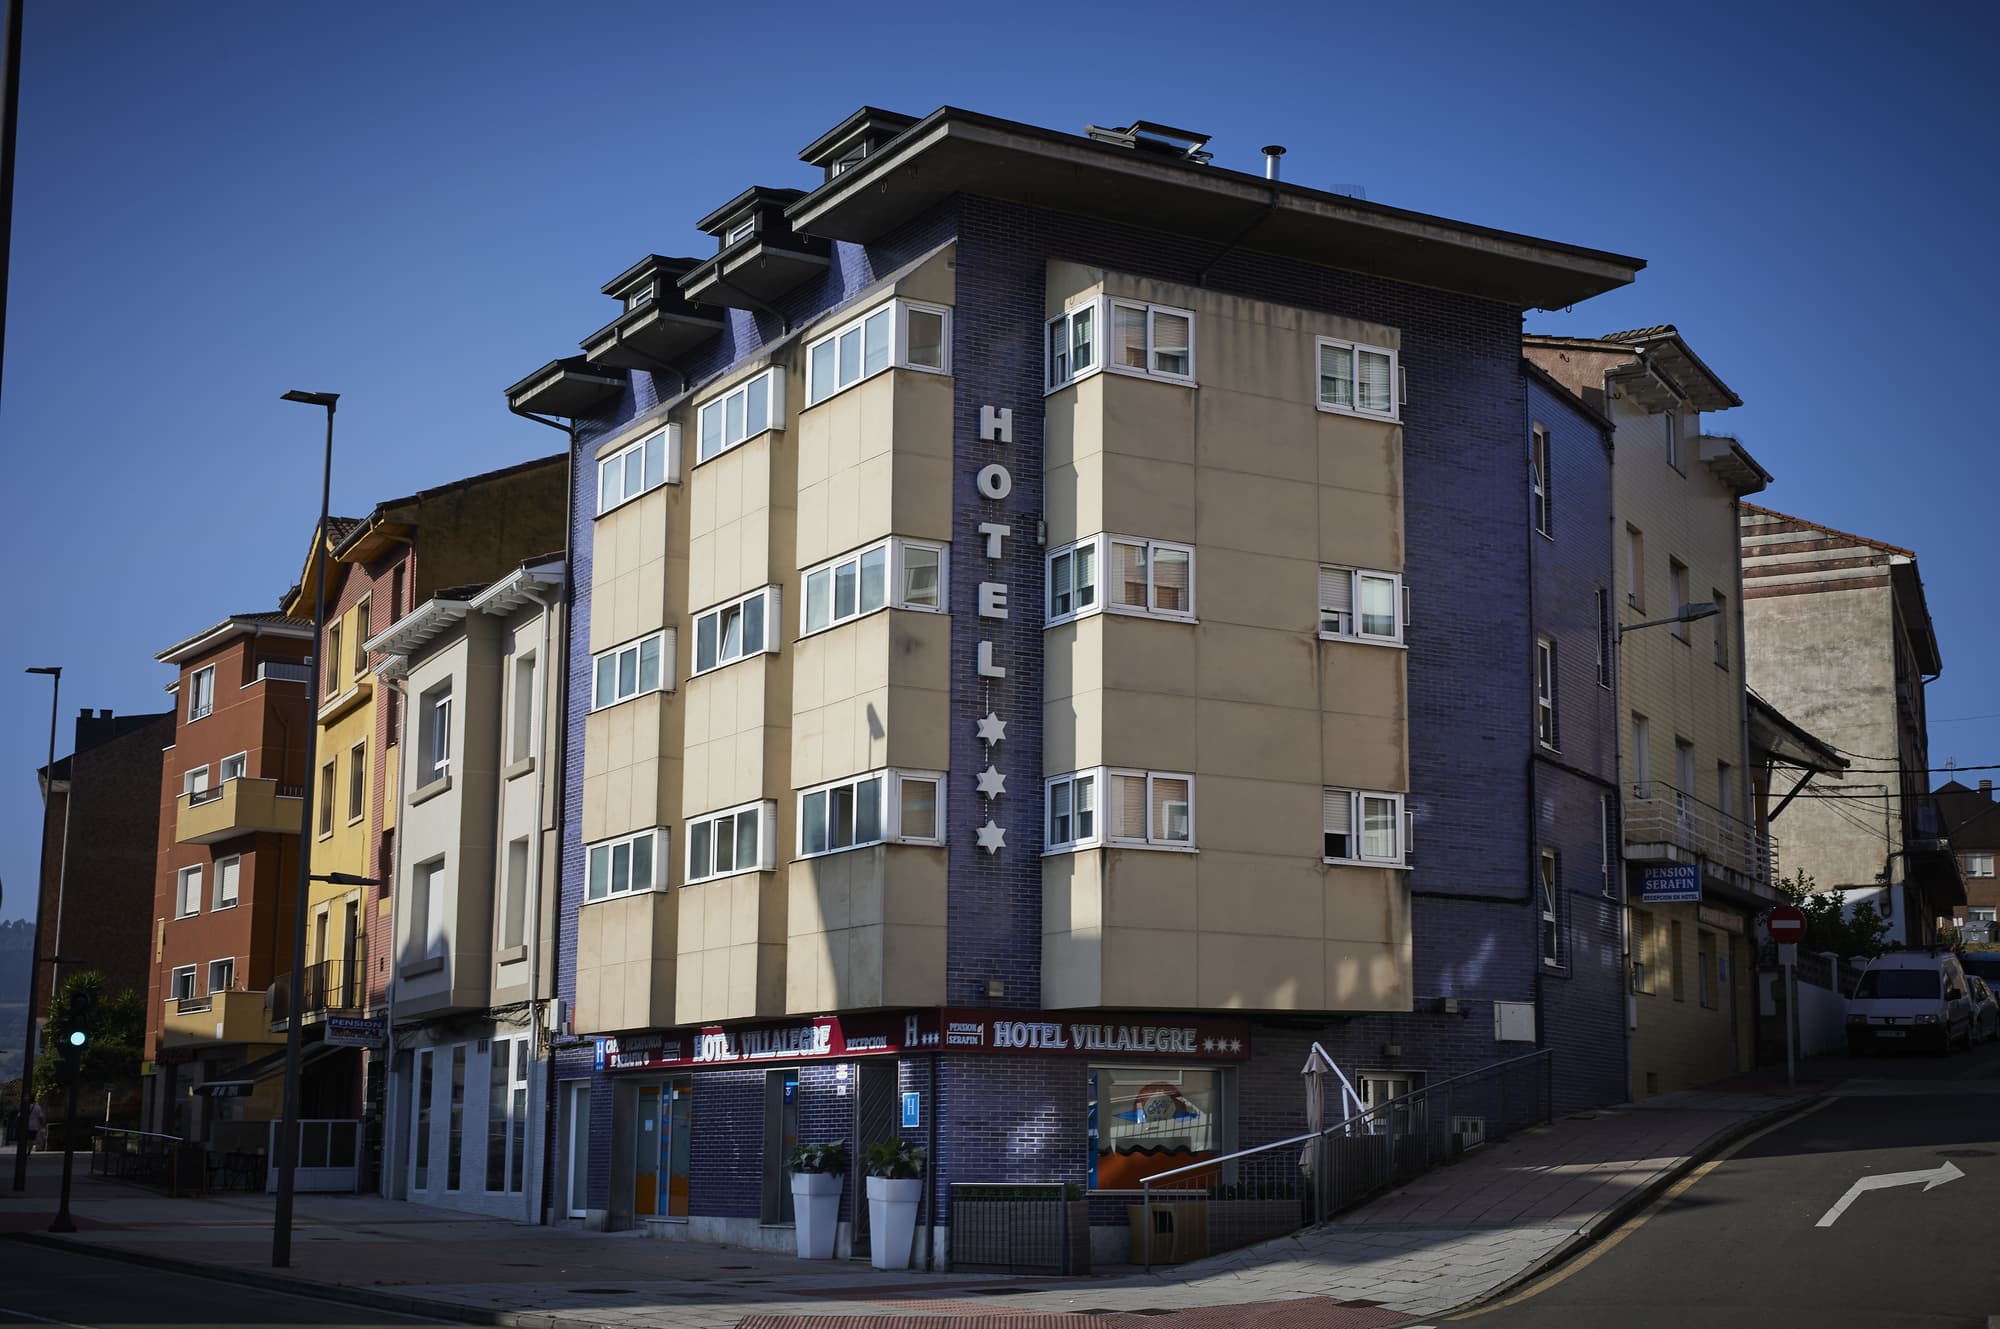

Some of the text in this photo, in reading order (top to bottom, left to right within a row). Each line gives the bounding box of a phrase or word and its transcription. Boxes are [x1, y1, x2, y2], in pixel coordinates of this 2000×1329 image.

[976, 404, 1012, 679] HOTEL
[1645, 867, 1695, 879] PENSION
[1645, 879, 1694, 890] SERAFIN
[331, 1018, 382, 1029] PENSION
[904, 1014, 919, 1047] H
[949, 1022, 978, 1032] PENSION
[693, 1032, 740, 1062] HOTEL
[741, 1024, 831, 1060] VILLALEGRE
[846, 1035, 888, 1051] RECEPCION
[949, 1035, 978, 1045] SERAFIN
[993, 1021, 1198, 1053] HOTEL VILLALEGRE
[906, 1098, 915, 1116] H
